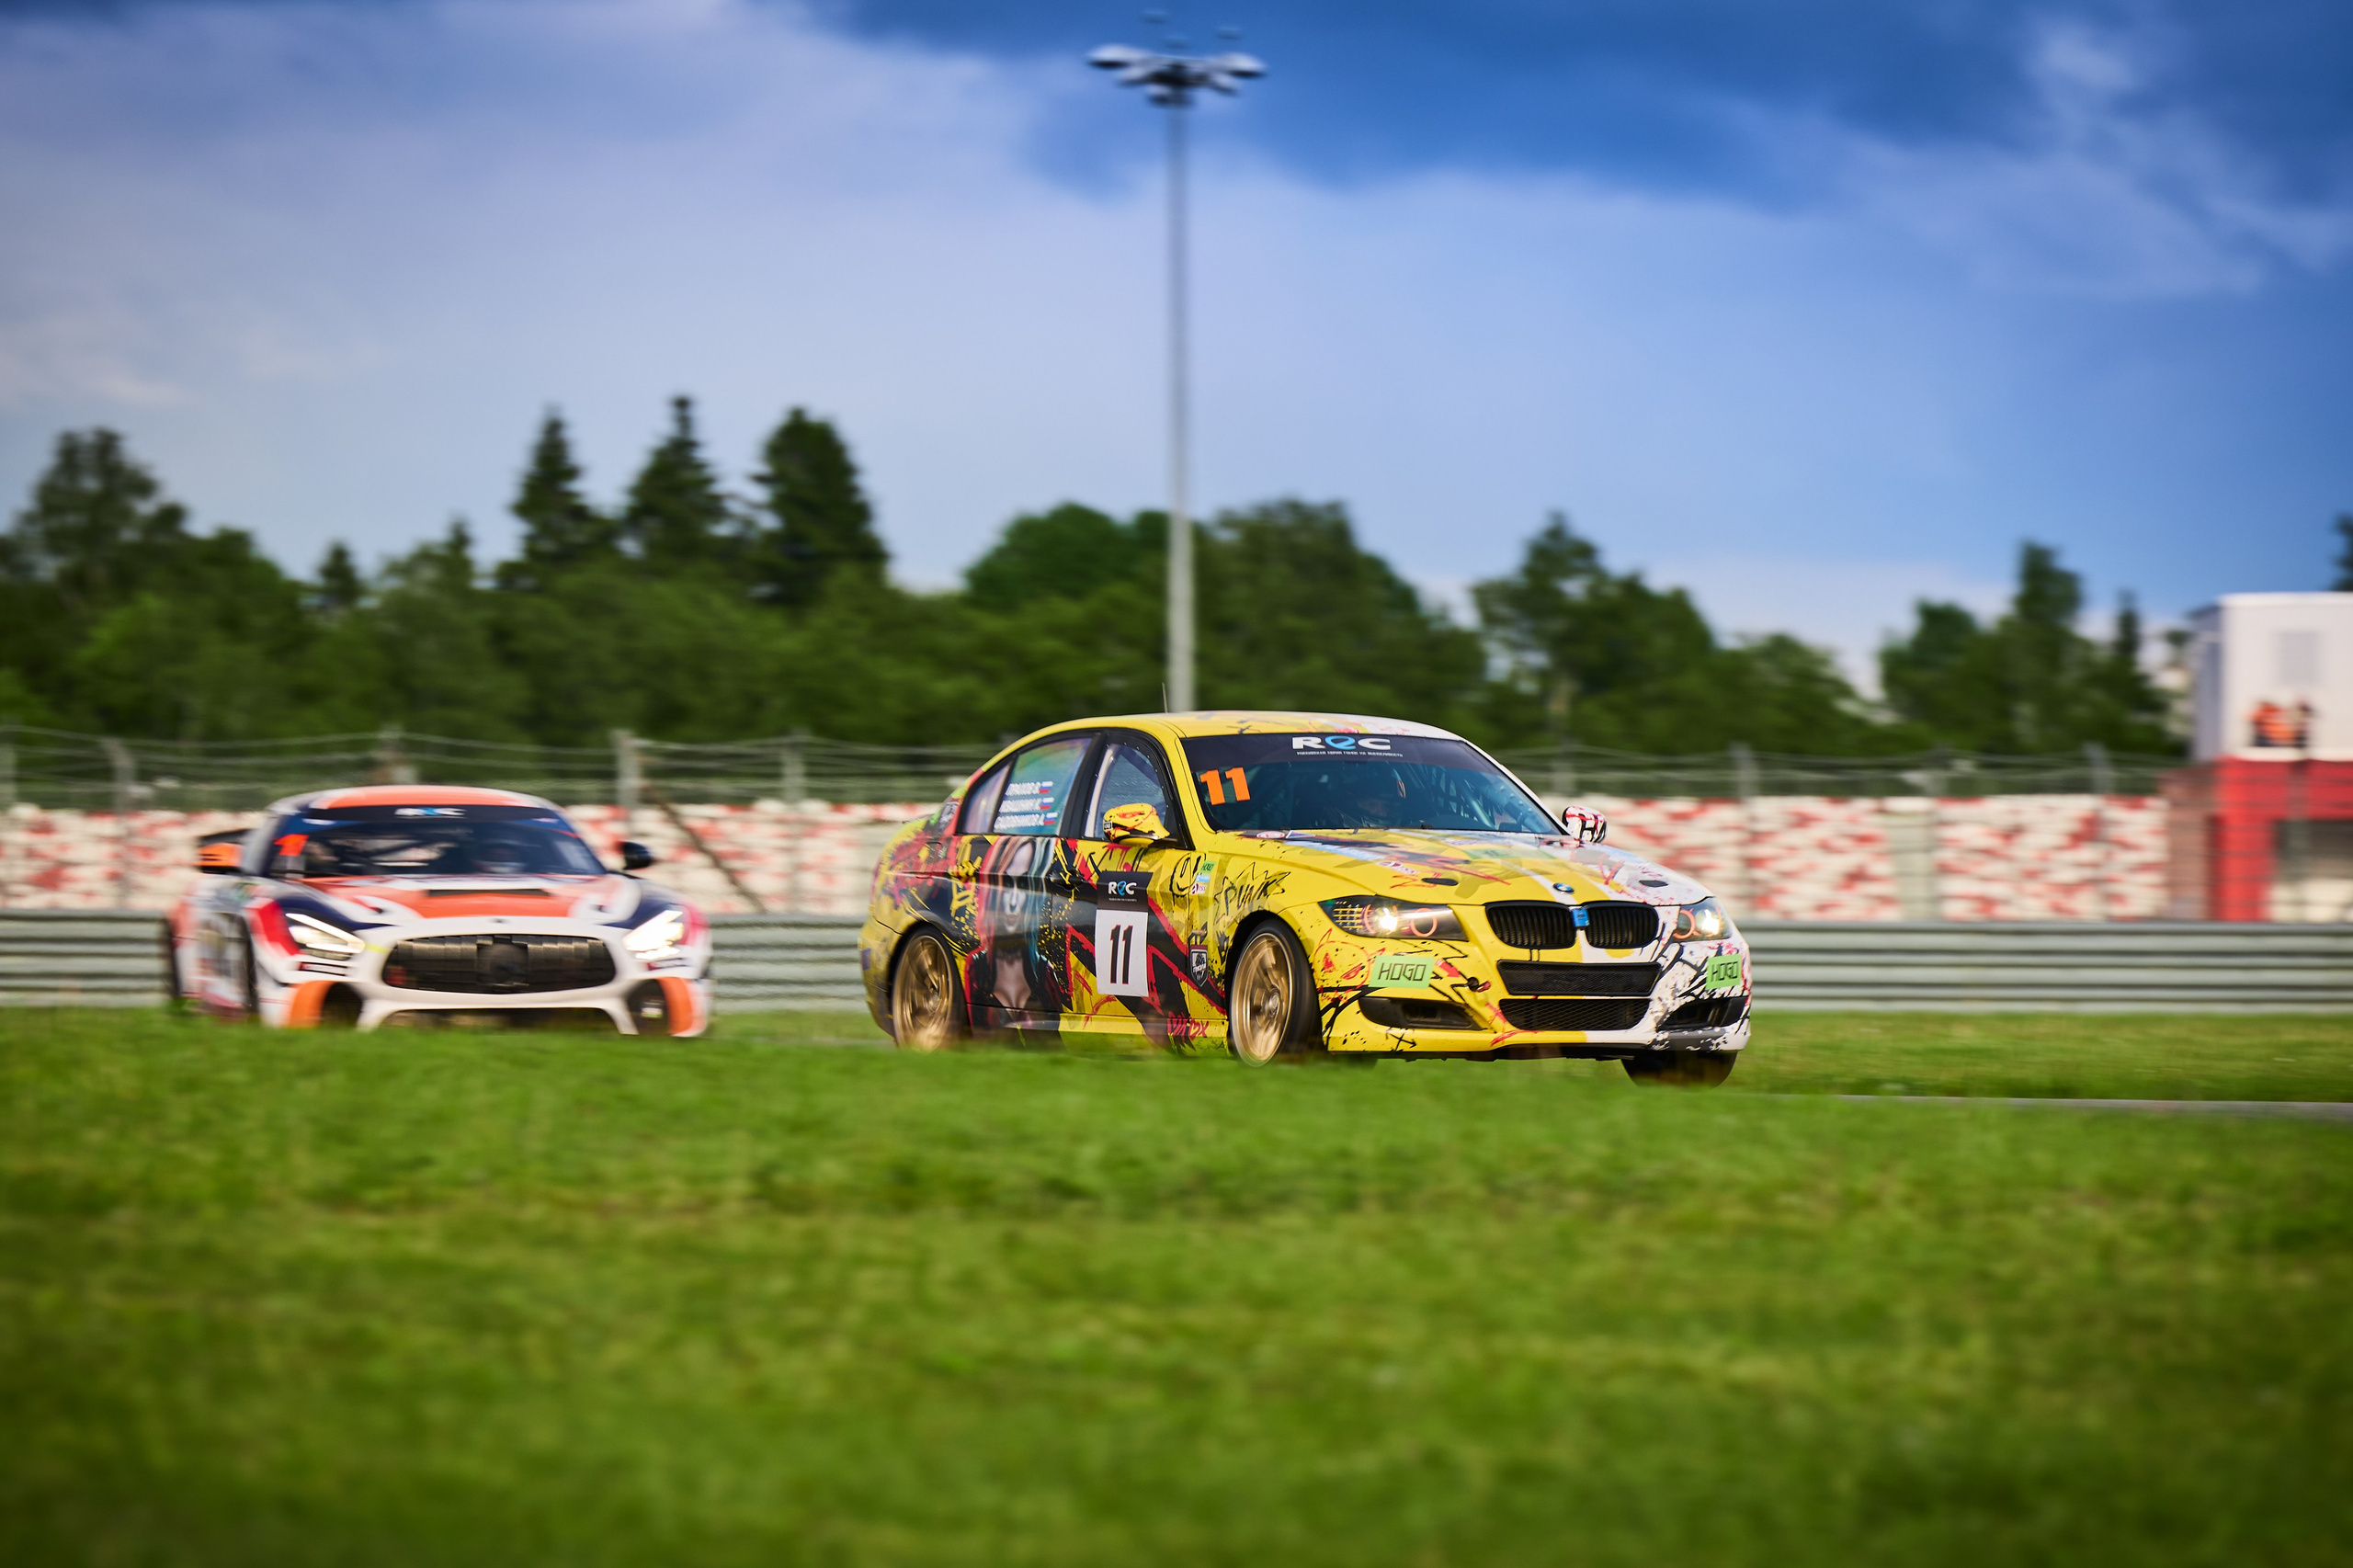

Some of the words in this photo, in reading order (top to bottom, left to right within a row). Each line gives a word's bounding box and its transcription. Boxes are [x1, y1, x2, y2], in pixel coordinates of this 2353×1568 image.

[1199, 767, 1251, 806] 11
[1109, 924, 1134, 984] 11
[1377, 962, 1427, 982] HOGO
[1710, 960, 1739, 983] HOGO
